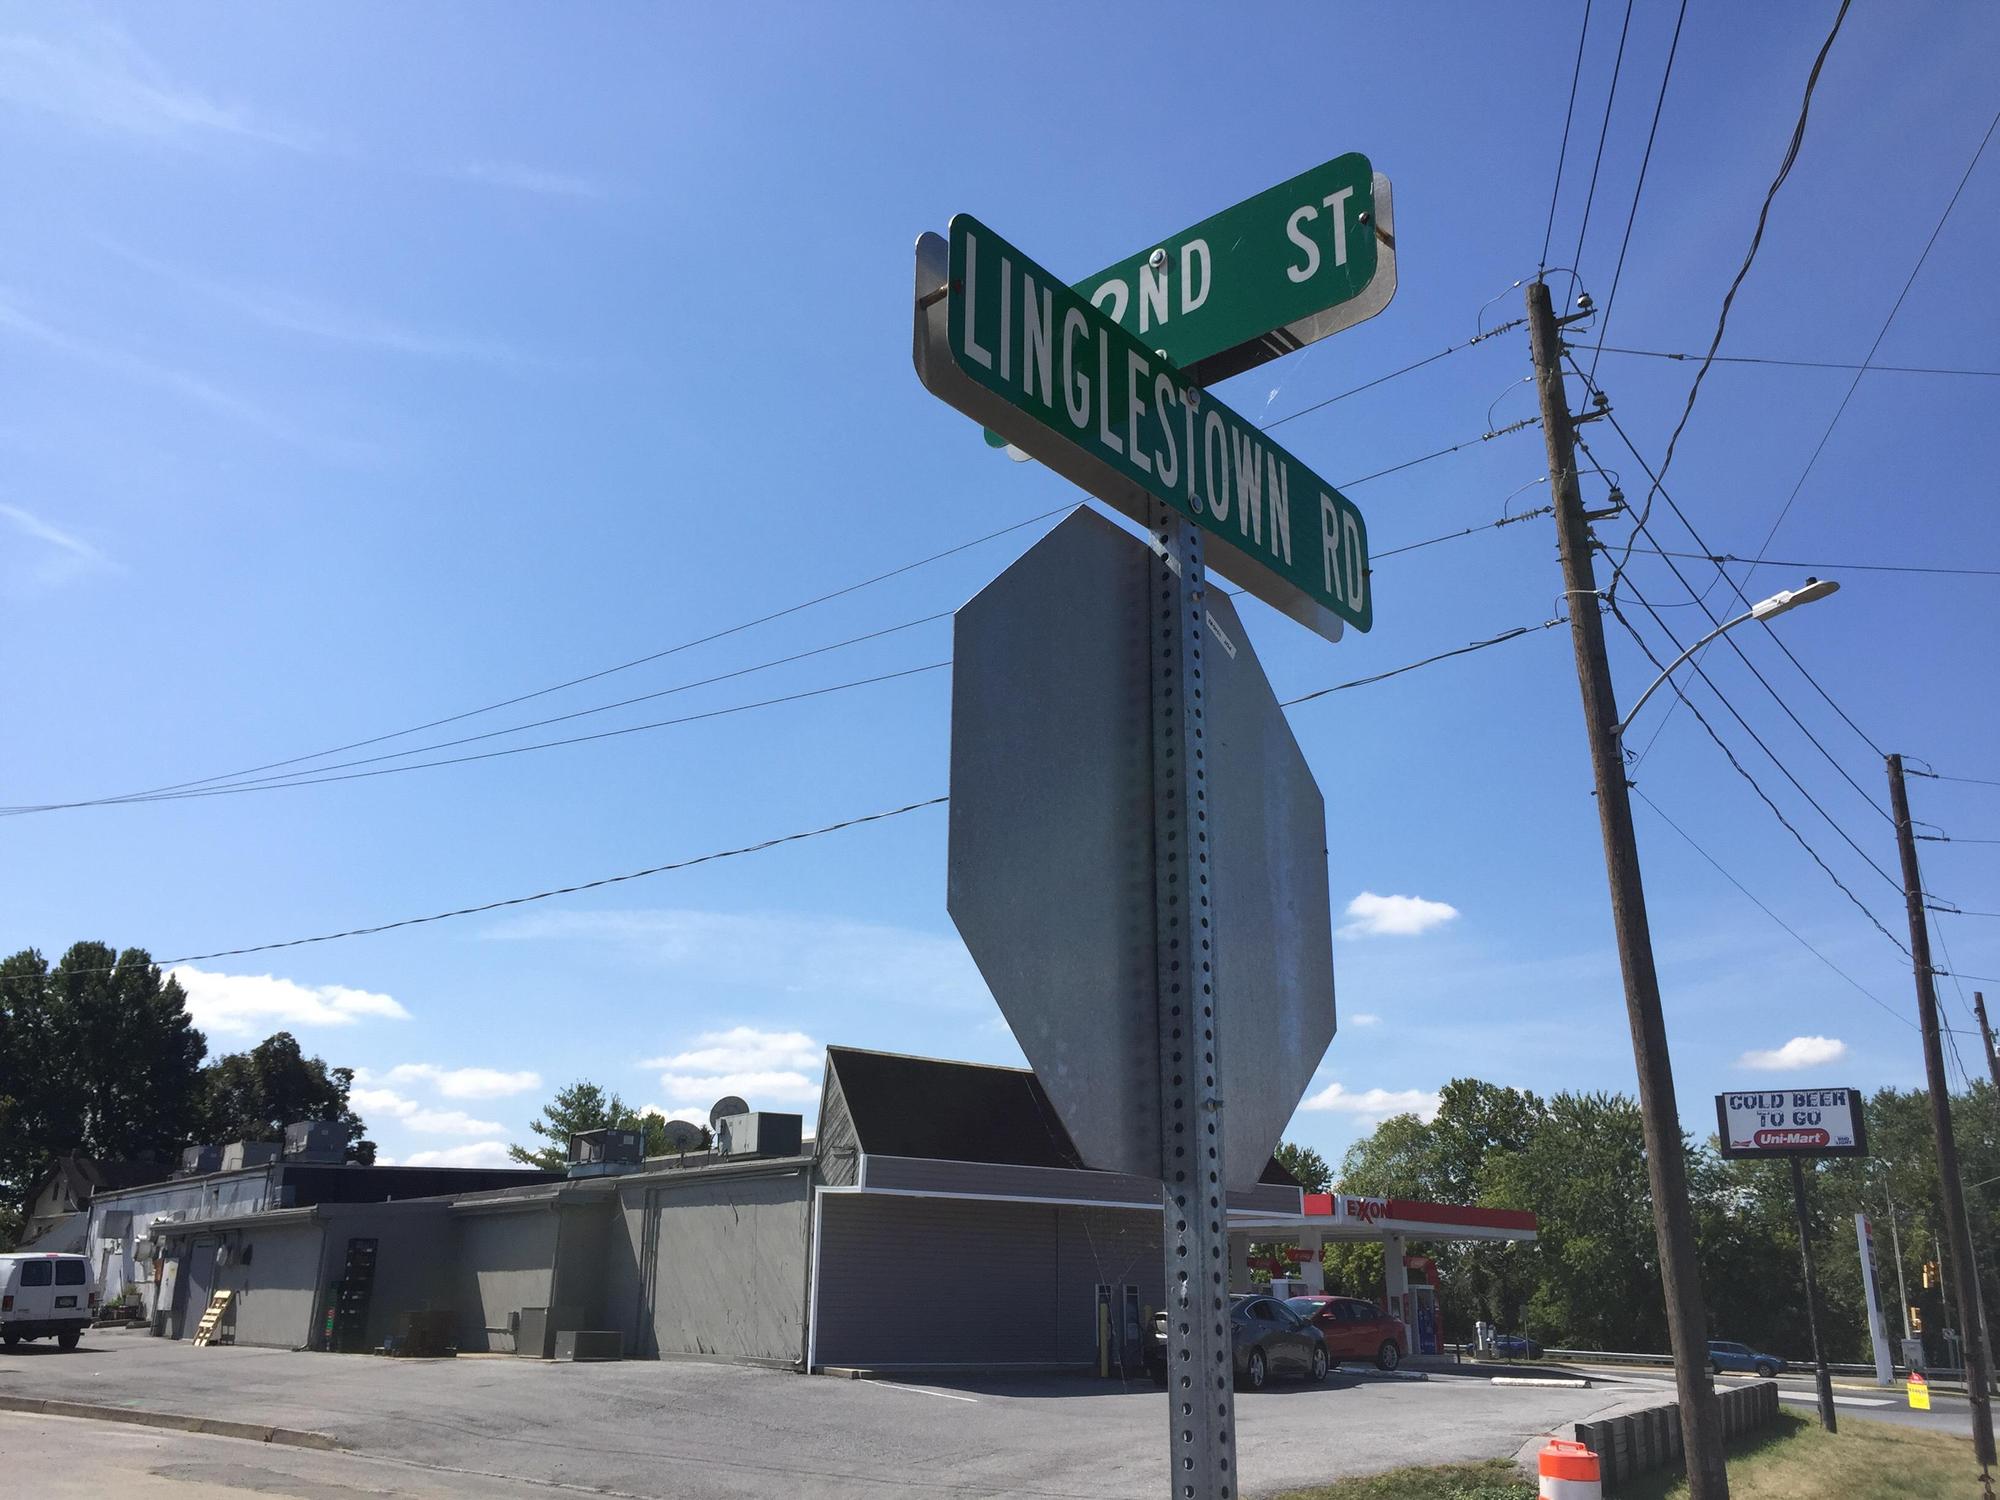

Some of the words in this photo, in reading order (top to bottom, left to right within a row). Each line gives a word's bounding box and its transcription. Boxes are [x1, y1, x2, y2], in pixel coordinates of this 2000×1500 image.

[1286, 185, 1354, 283] ST
[964, 231, 1292, 567] LINGLESTOWN
[1320, 492, 1364, 613] RD
[1730, 1094, 1784, 1110] COLD
[1793, 1091, 1846, 1107] BEER
[1757, 1111, 1784, 1127] TO
[1793, 1110, 1821, 1126] GO
[1760, 1132, 1821, 1145] Uni-Mart
[1347, 1199, 1392, 1224] EXXON
